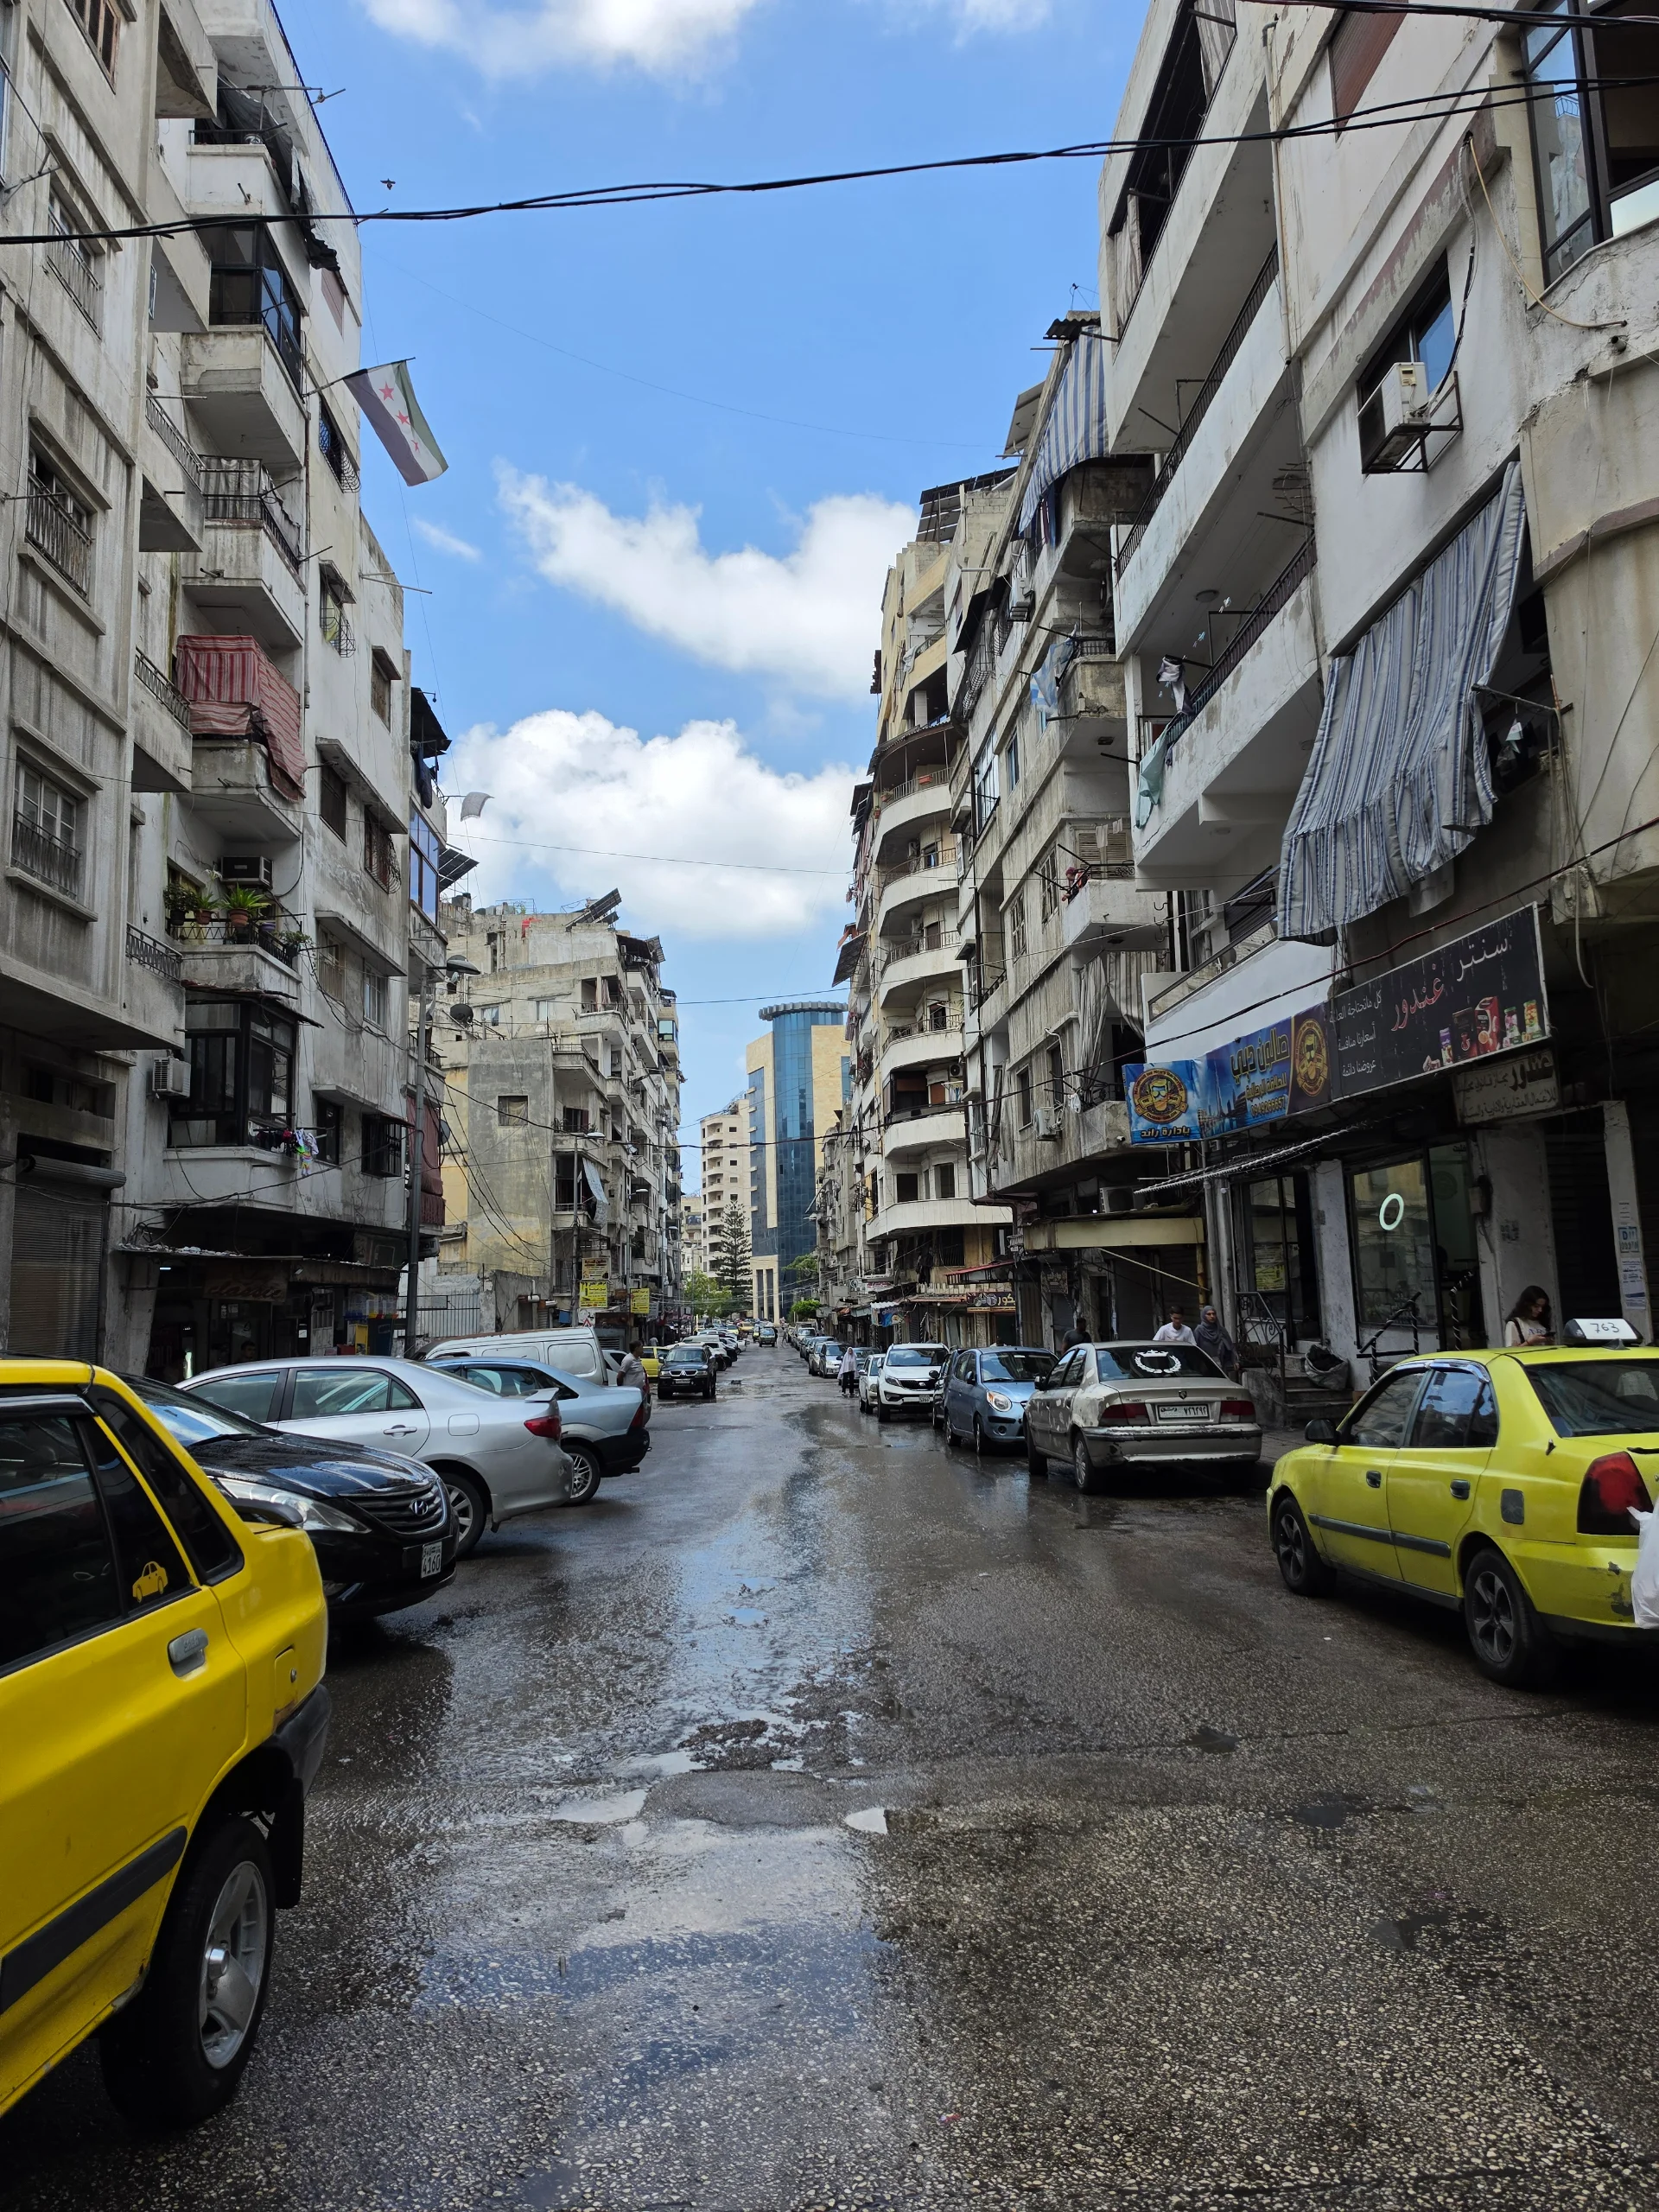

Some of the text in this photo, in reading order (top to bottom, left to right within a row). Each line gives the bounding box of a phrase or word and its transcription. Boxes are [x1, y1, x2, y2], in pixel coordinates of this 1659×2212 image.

[1390, 938, 1509, 1032] سنتر غندور
[1374, 988, 1382, 1009] كل
[1338, 1020, 1376, 1052] أسعارنا منافسة
[1257, 1027, 1290, 1072] صالون
[1230, 1045, 1256, 1084] دبي
[1342, 1058, 1376, 1077] عروضنا دائمة
[1265, 1072, 1287, 1094] للحلاقة
[1589, 1321, 1620, 1334] 763
[423, 1554, 441, 1574] 4160
